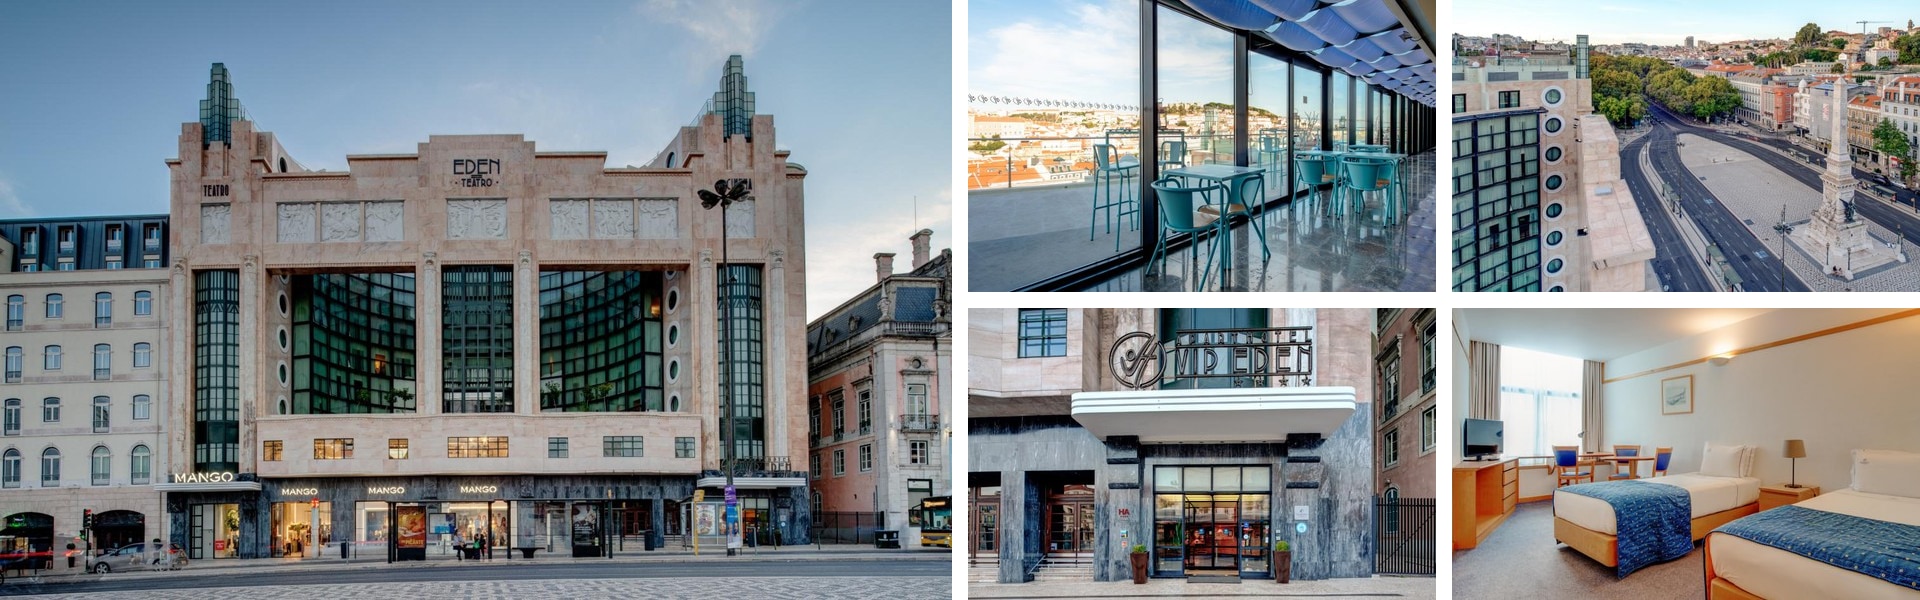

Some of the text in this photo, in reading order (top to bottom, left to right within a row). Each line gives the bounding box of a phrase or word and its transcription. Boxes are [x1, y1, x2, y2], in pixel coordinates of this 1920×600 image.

[453, 159, 500, 175] EDEN
[461, 178, 492, 187] TEATRO
[203, 184, 230, 197] TEATRO
[1176, 329, 1313, 346] APARTHOTEL
[1176, 345, 1313, 375] VIP EDEN
[174, 471, 234, 483] MANGO
[281, 488, 319, 496] MANGO
[368, 486, 405, 495] MANGO
[460, 485, 498, 494] MANGO
